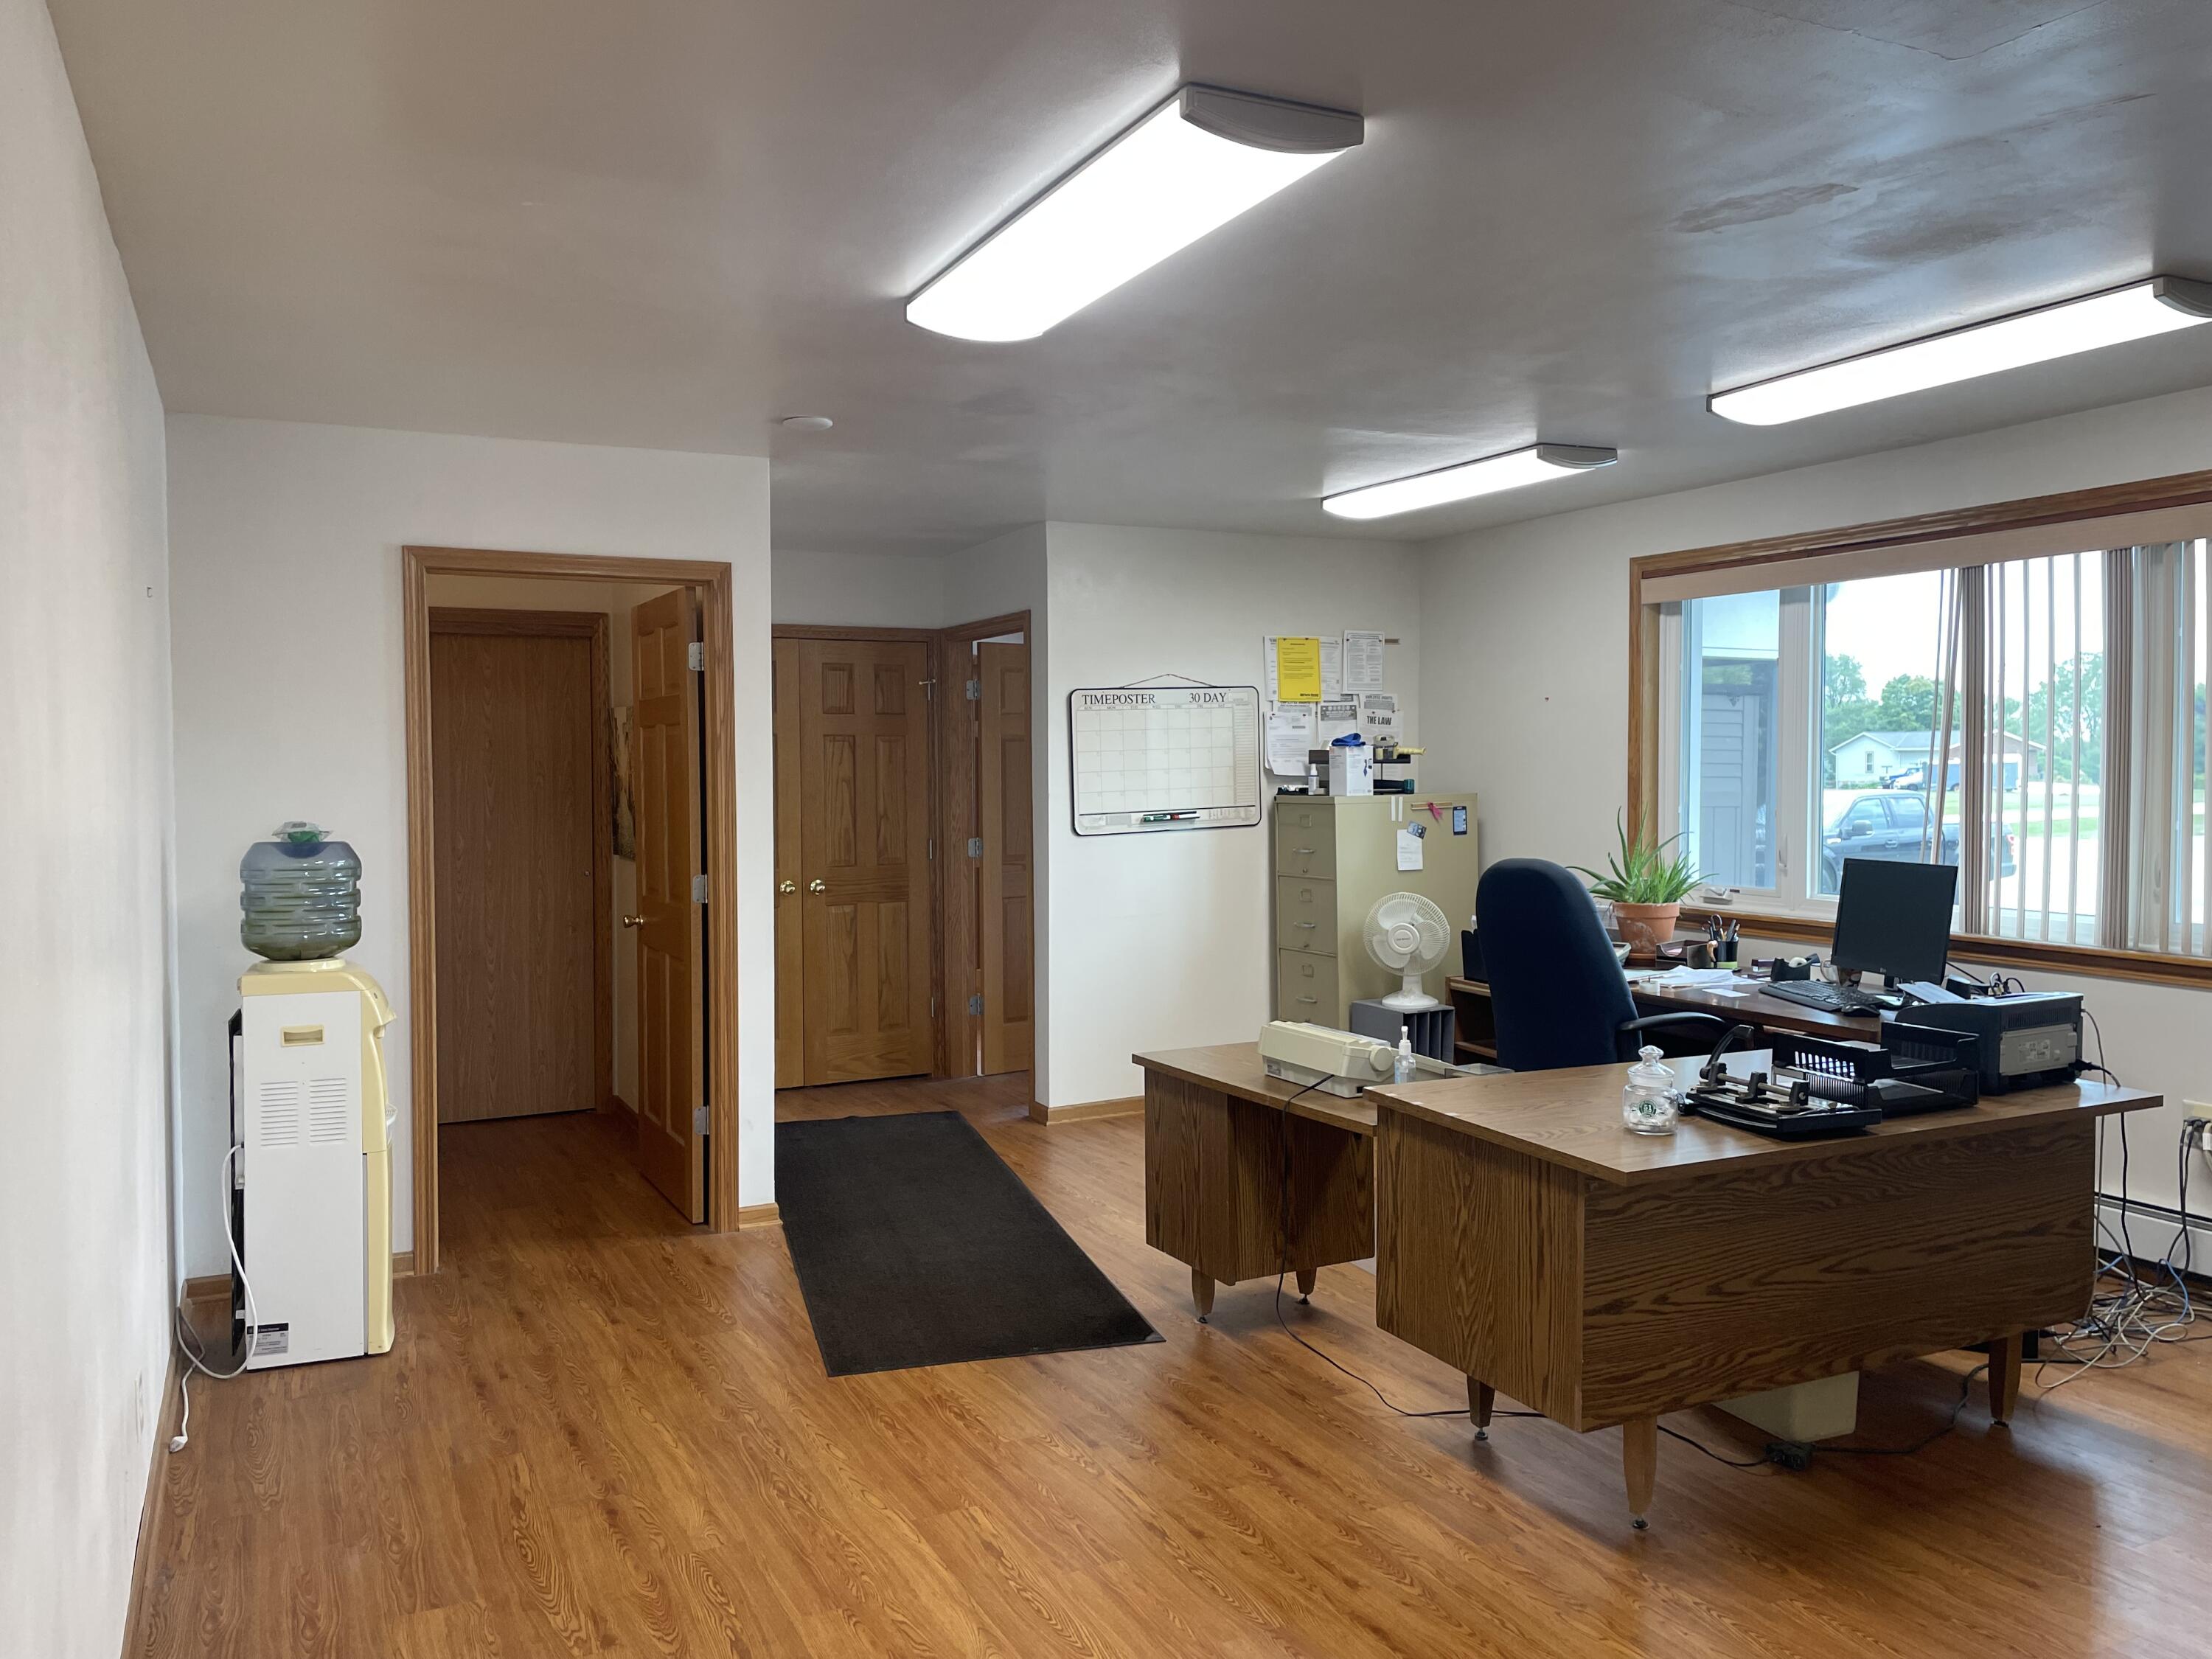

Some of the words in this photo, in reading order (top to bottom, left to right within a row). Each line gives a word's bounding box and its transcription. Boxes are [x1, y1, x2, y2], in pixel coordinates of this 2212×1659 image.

[1082, 694, 1155, 705] TIMEPOSTER
[1189, 693, 1200, 703] 30
[1203, 693, 1226, 703] DAY
[1367, 716, 1377, 724] THE
[1377, 717, 1392, 726] LAW
